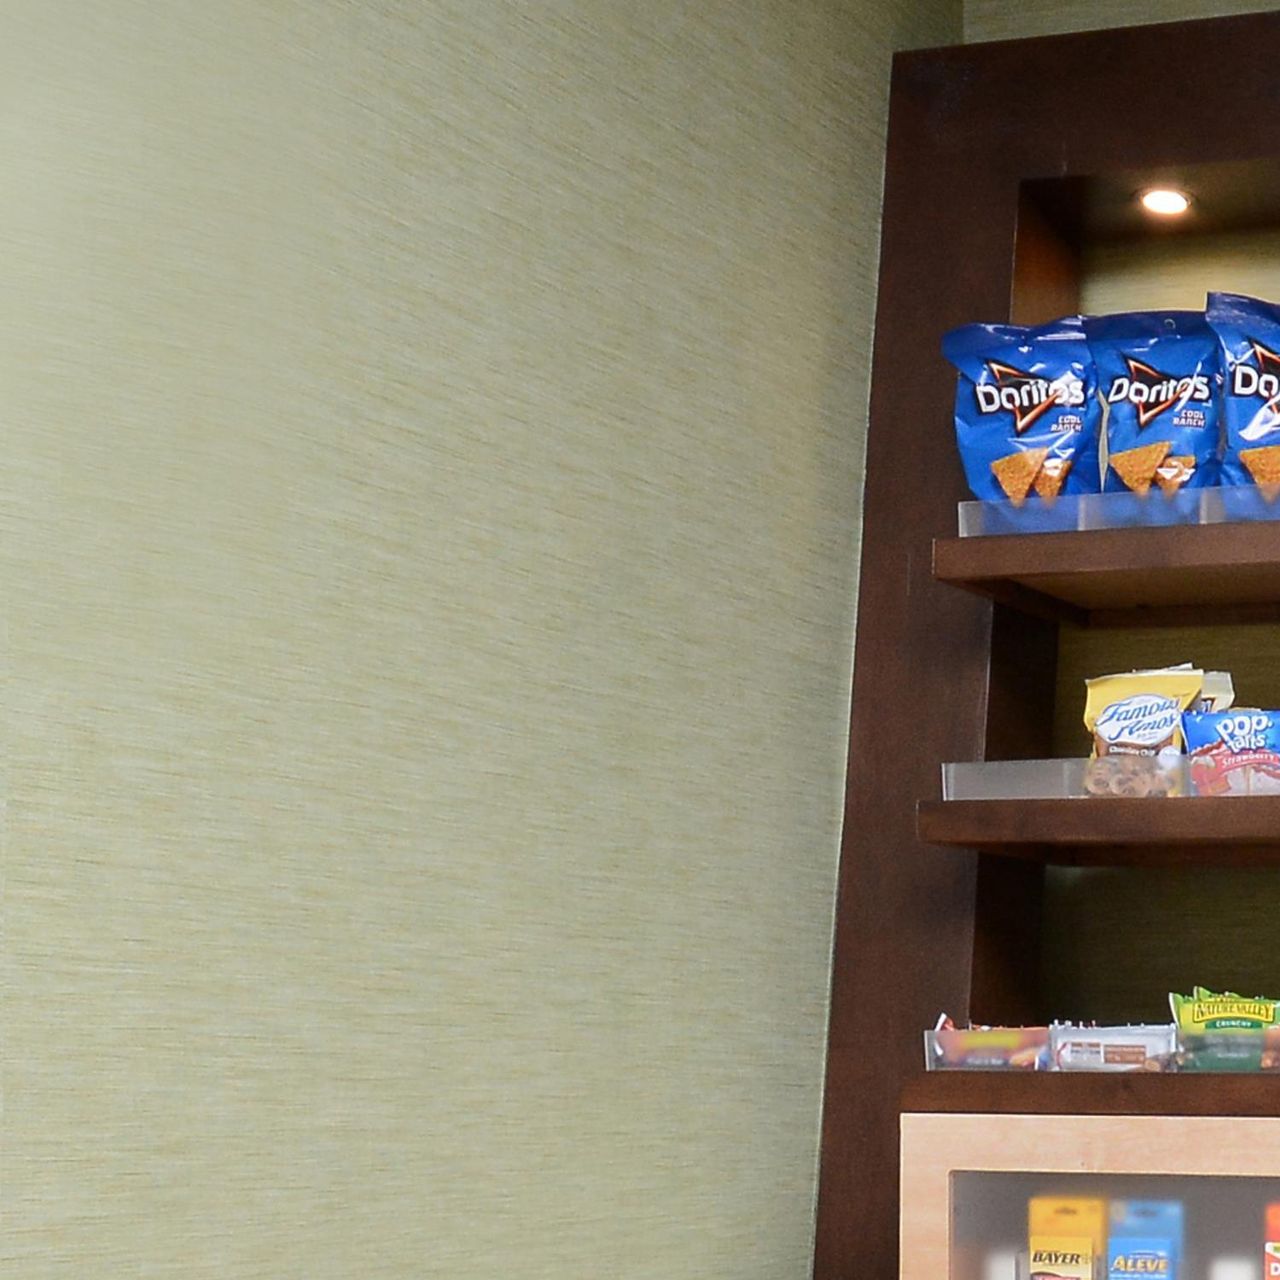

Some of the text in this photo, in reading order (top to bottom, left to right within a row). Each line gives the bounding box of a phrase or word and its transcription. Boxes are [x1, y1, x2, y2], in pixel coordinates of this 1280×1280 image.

[977, 379, 1085, 413] Doritos
[1108, 376, 1210, 403] Doritos
[1058, 415, 1082, 424] COOL
[1172, 417, 1206, 427] RANCH
[1181, 410, 1204, 419] COOL
[1050, 423, 1083, 432] RANCH
[1095, 699, 1179, 727] Famous
[1108, 714, 1176, 741] Amos
[1220, 750, 1276, 768] Strawberry
[1195, 1001, 1274, 1021] NATURE VALLEY
[1215, 1020, 1253, 1029] CRUNCHY
[1032, 1250, 1082, 1265] BAYER
[1113, 1255, 1169, 1272] ALEVE
